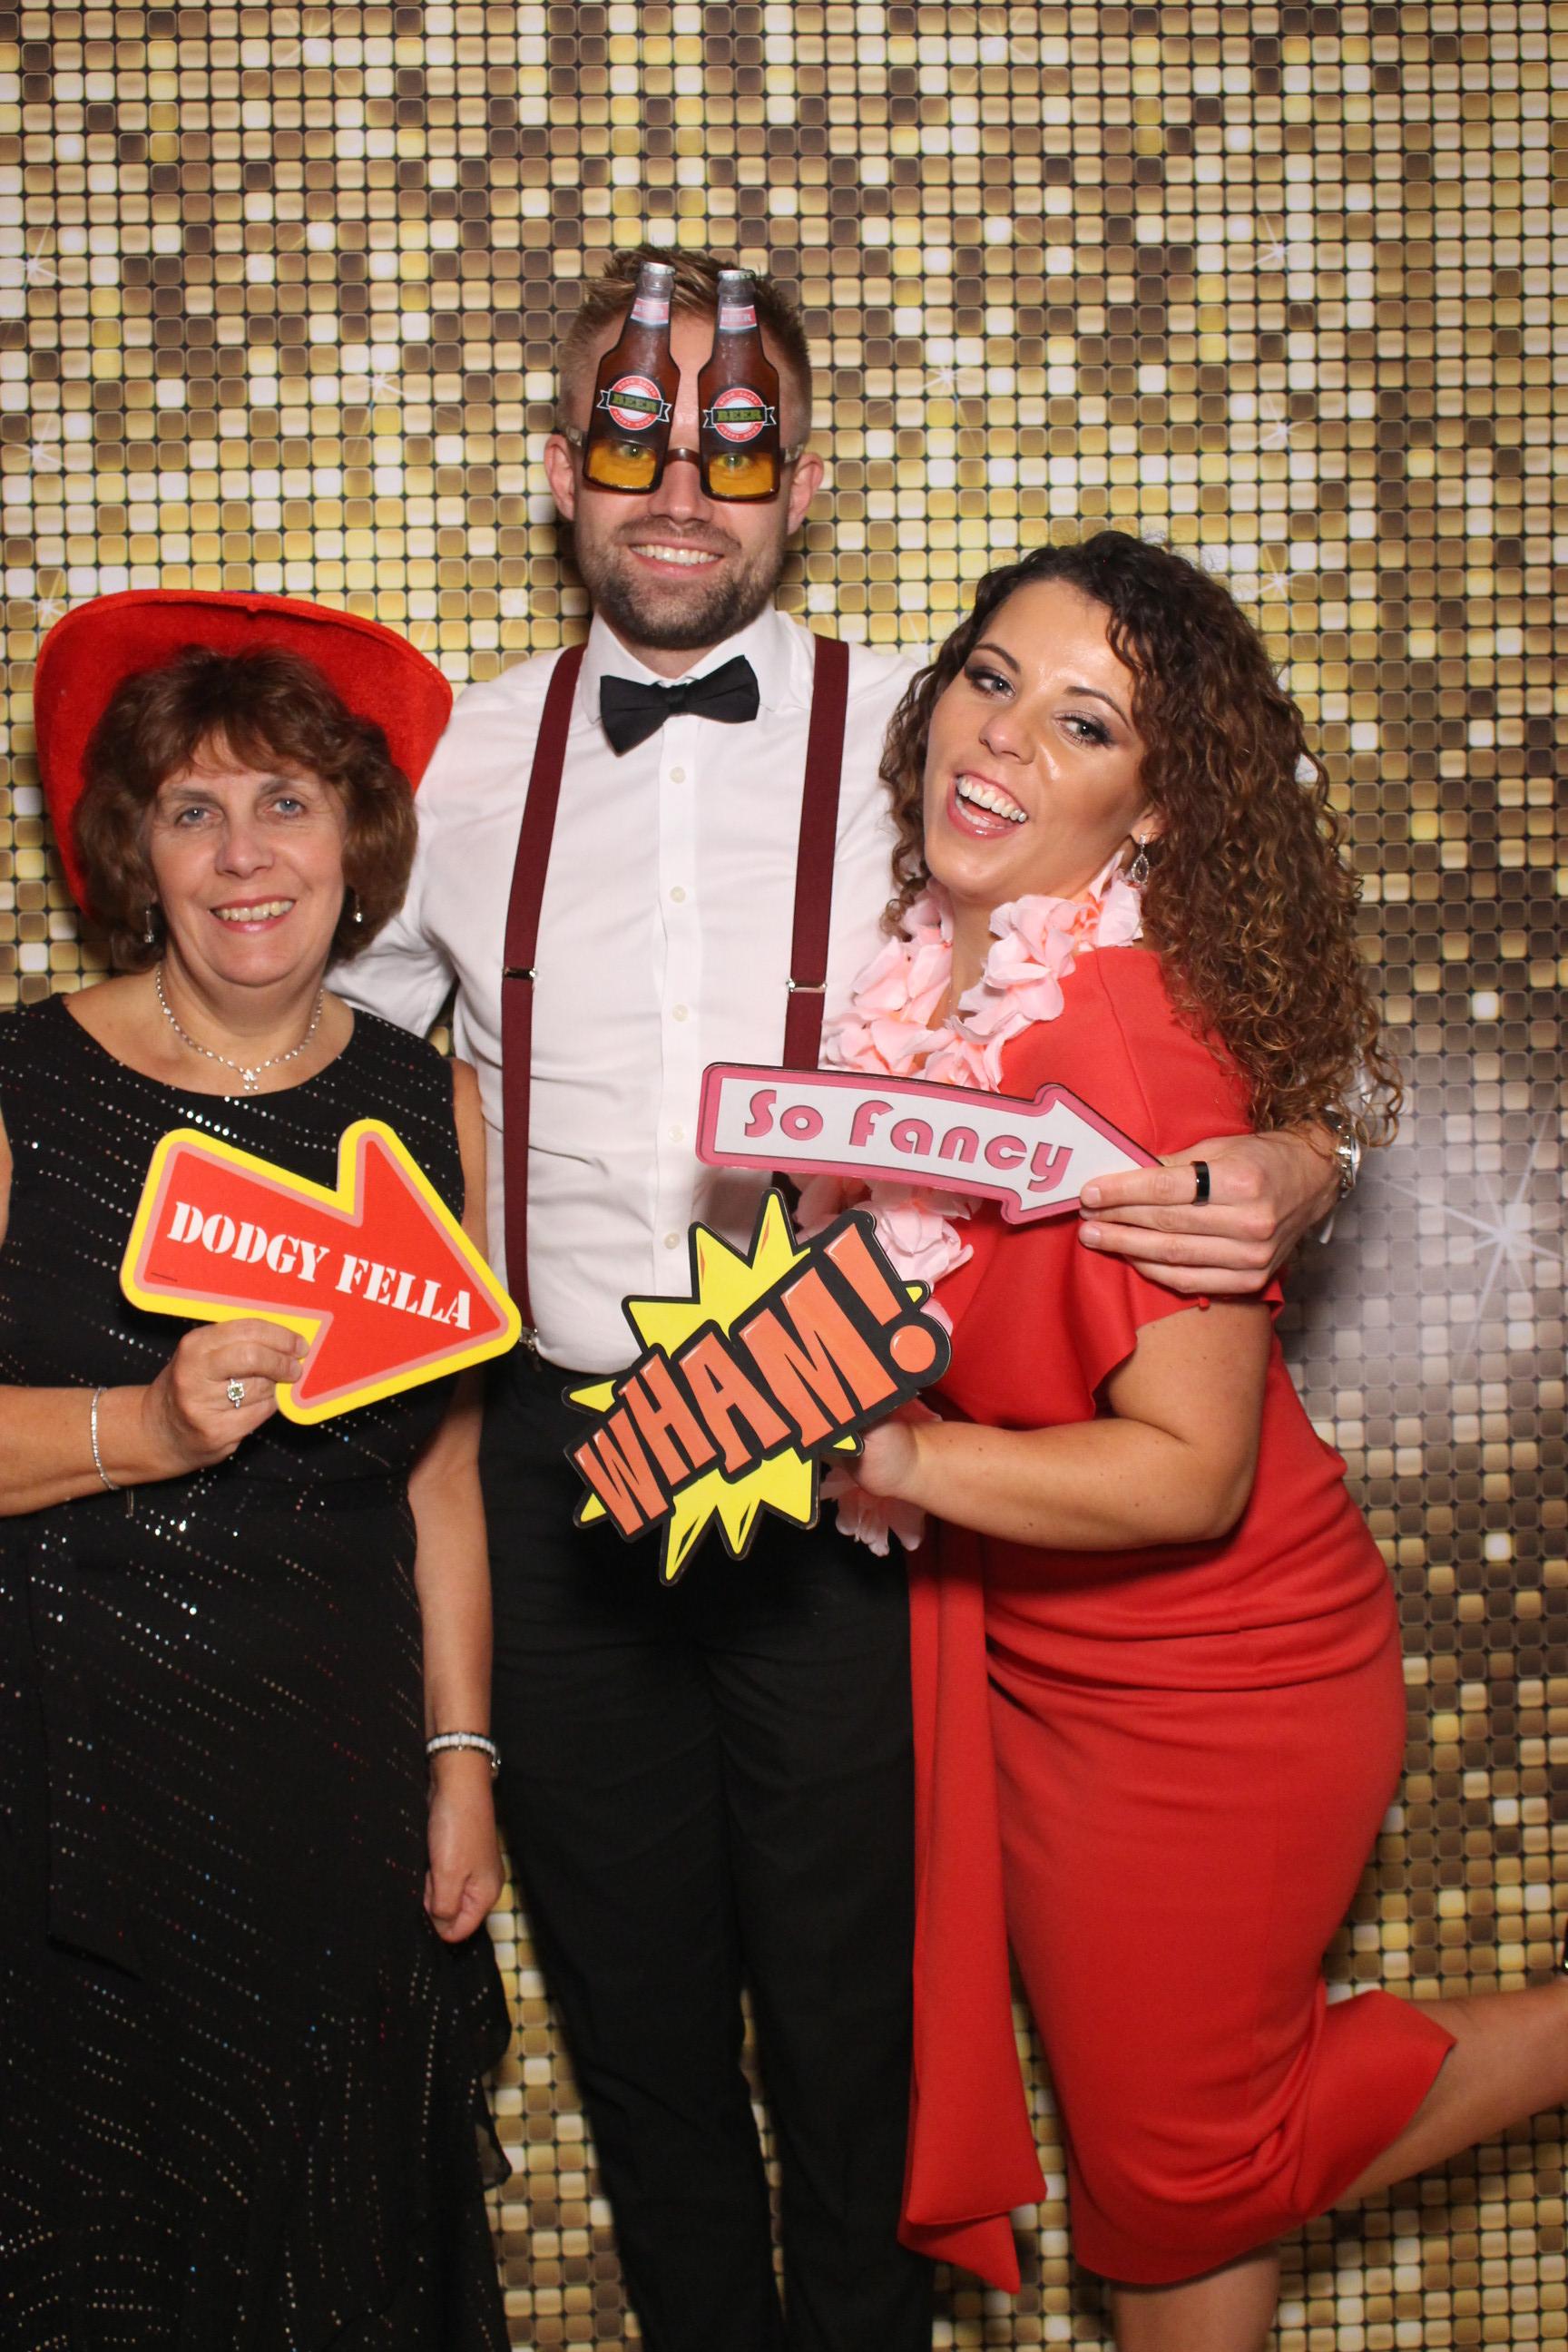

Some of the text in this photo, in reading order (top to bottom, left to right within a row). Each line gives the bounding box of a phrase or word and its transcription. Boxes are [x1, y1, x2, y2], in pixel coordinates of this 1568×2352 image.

[612, 394, 658, 414] BEER
[717, 409, 762, 421] BEER
[744, 1089, 824, 1142] So
[167, 1201, 472, 1331] DODGY FELLA
[573, 1222, 936, 1536] WHAM!
